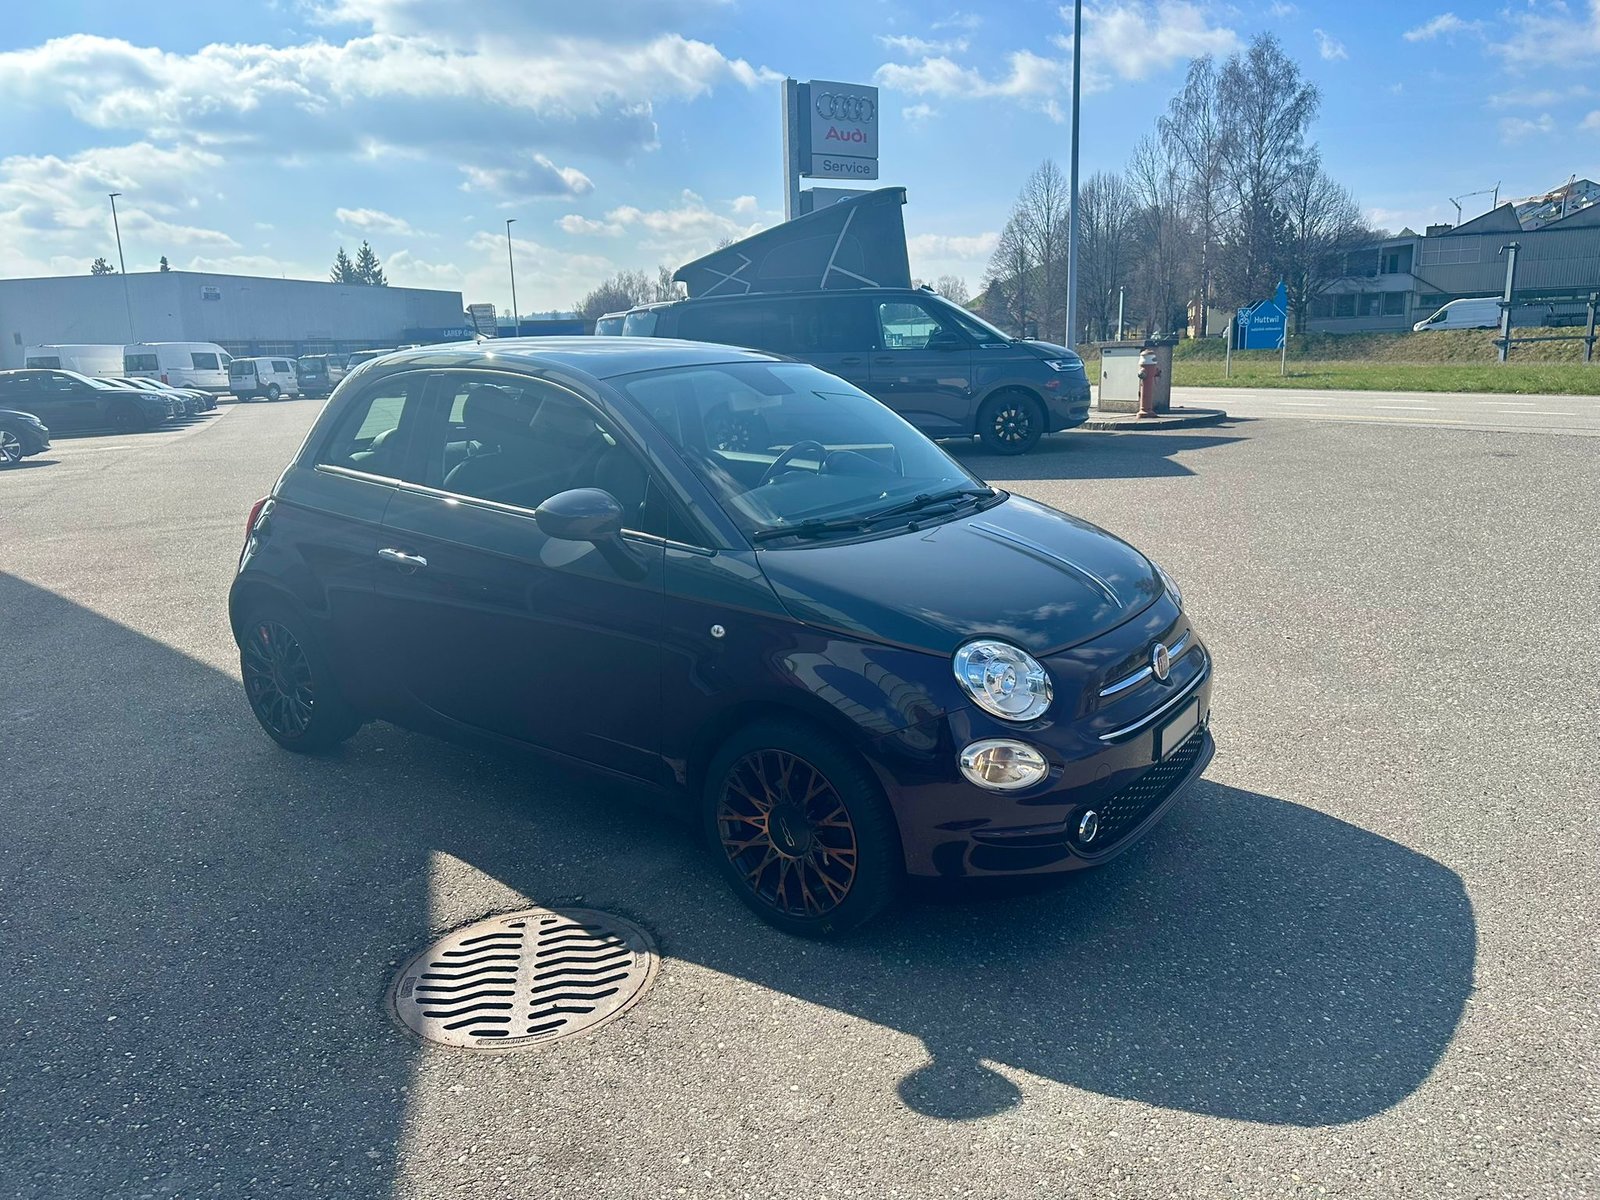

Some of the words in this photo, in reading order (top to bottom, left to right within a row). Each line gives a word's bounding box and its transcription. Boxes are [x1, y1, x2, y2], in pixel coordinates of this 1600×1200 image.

[825, 126, 868, 143] Audi
[823, 159, 871, 174] Service
[1254, 315, 1280, 324] Huttwil
